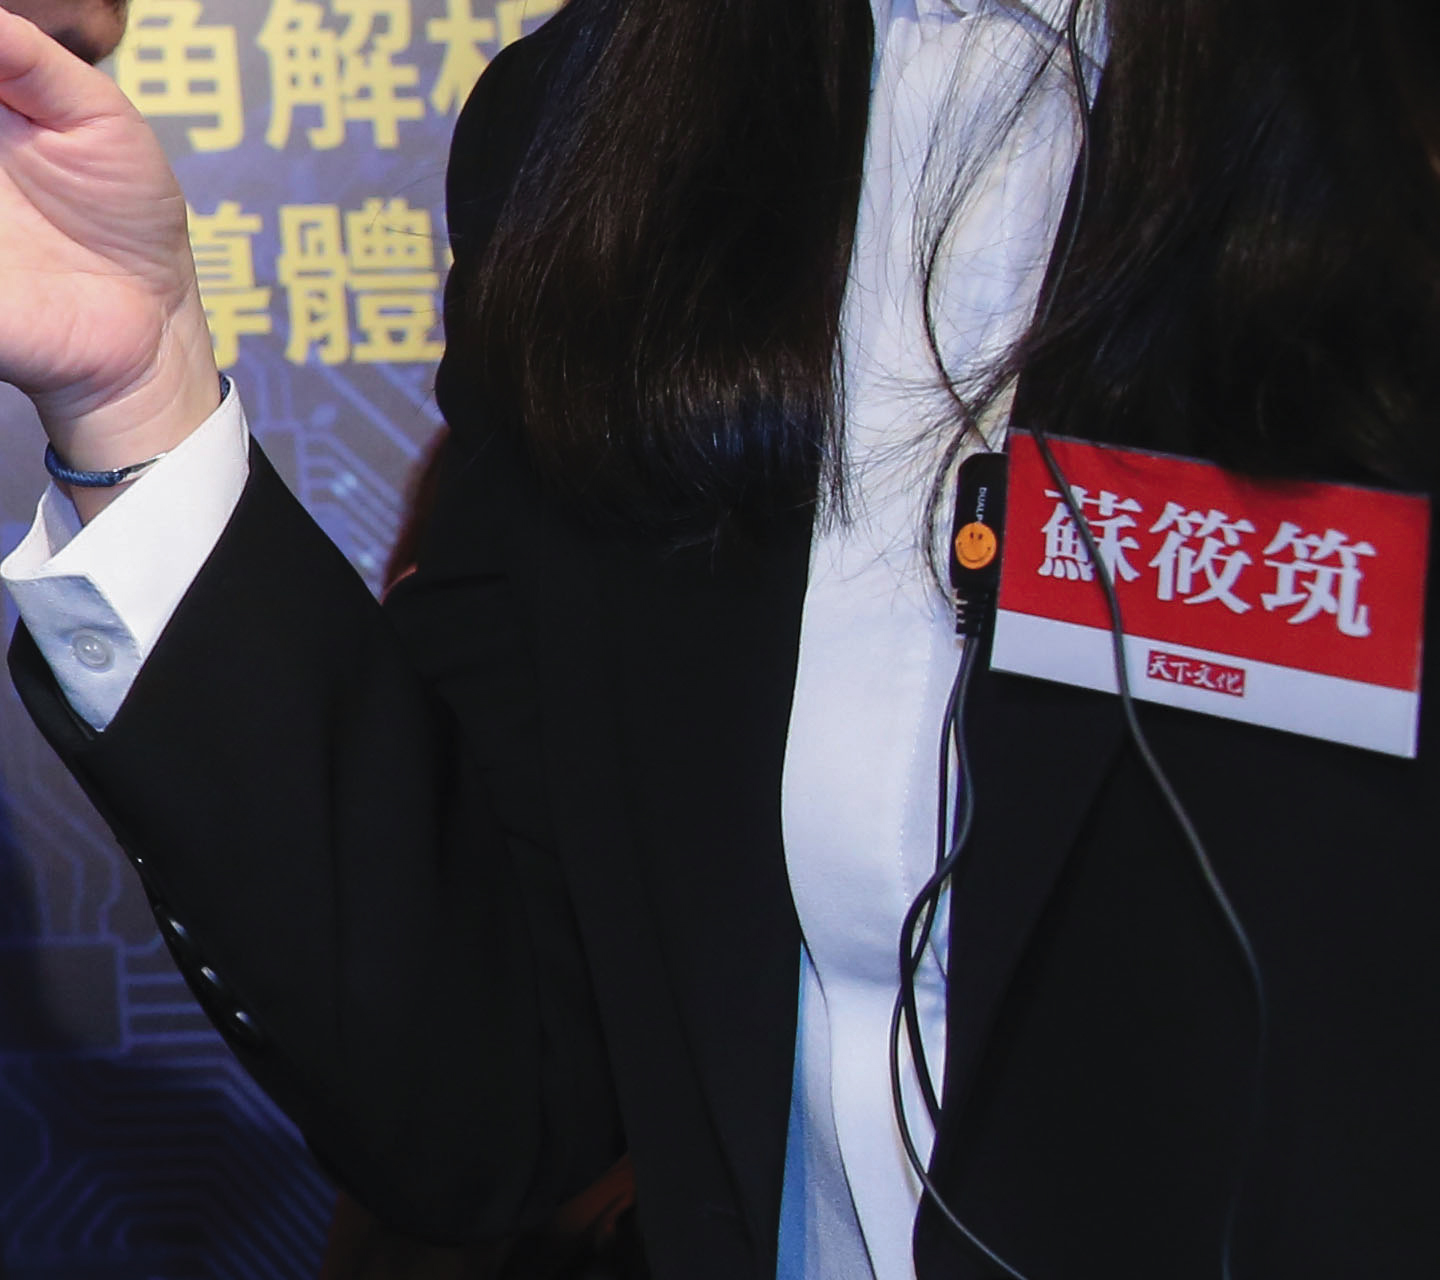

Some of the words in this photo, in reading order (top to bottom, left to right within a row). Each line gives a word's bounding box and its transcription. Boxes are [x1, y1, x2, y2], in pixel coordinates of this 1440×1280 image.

[187, 197, 455, 370] 導體
[1038, 484, 1377, 638] 蘇筱筑
[1147, 654, 1243, 694] 天下文化
